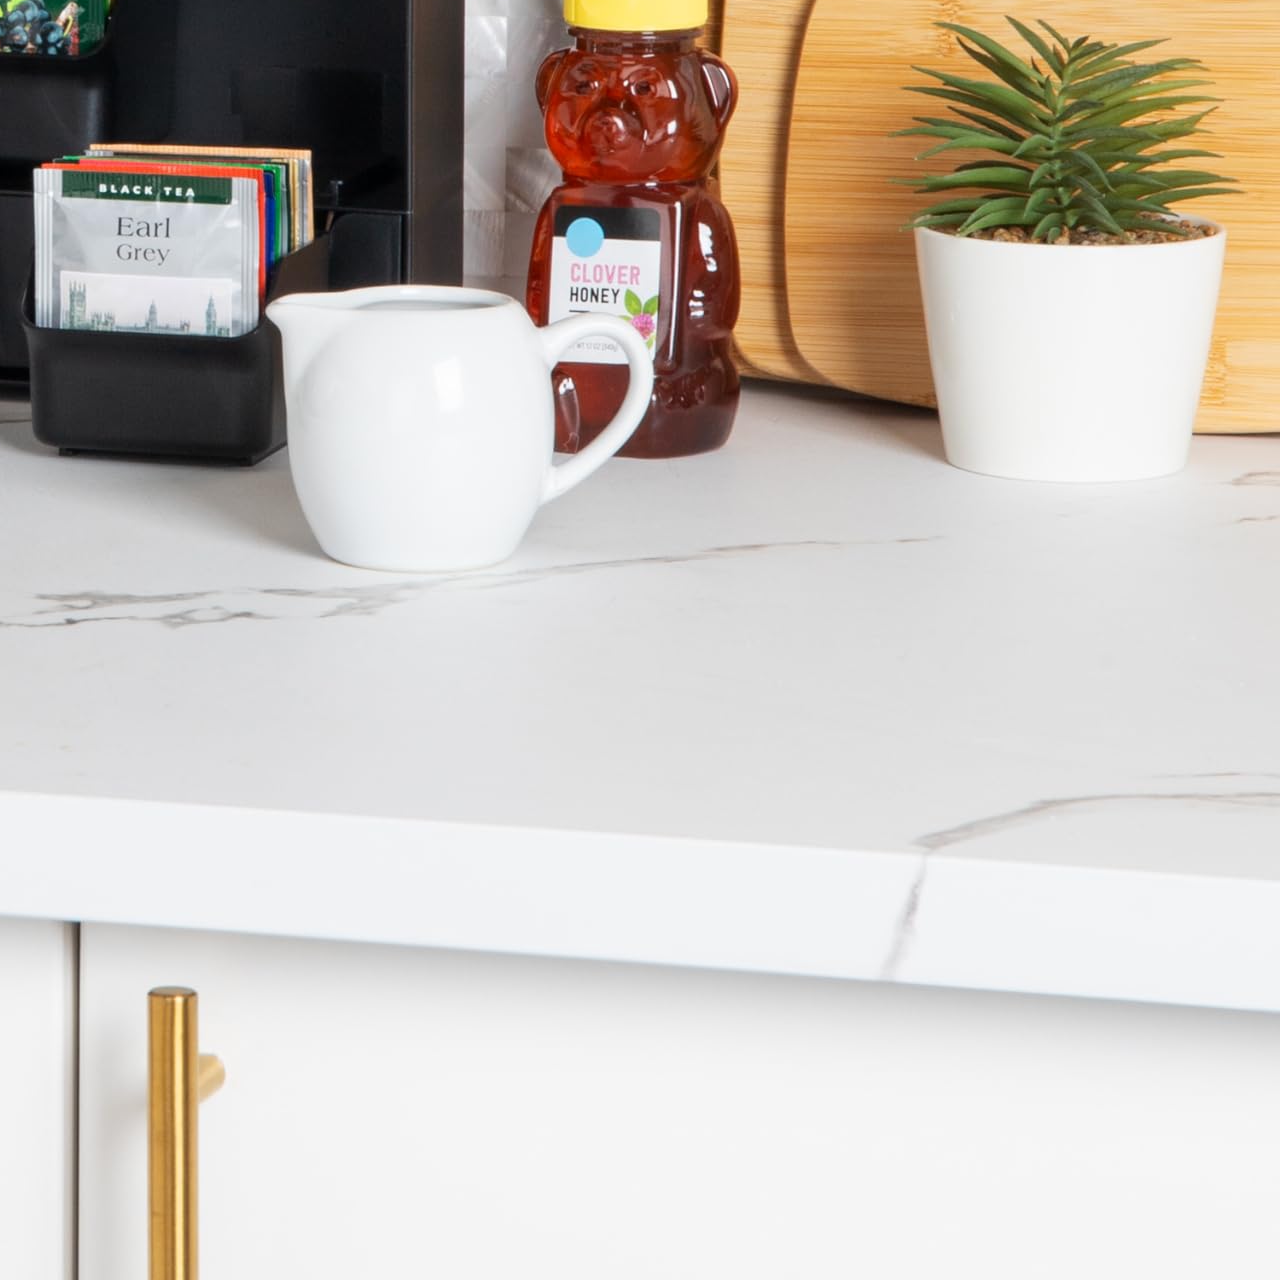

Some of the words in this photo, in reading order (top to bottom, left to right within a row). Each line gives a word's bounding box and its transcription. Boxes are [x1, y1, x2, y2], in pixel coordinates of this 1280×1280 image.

[99, 183, 154, 196] BLACK
[164, 186, 196, 198] TEA
[116, 216, 170, 239] Earl
[116, 243, 170, 266] Grey
[571, 263, 641, 286] CLOVER
[570, 287, 620, 304] HONEY
